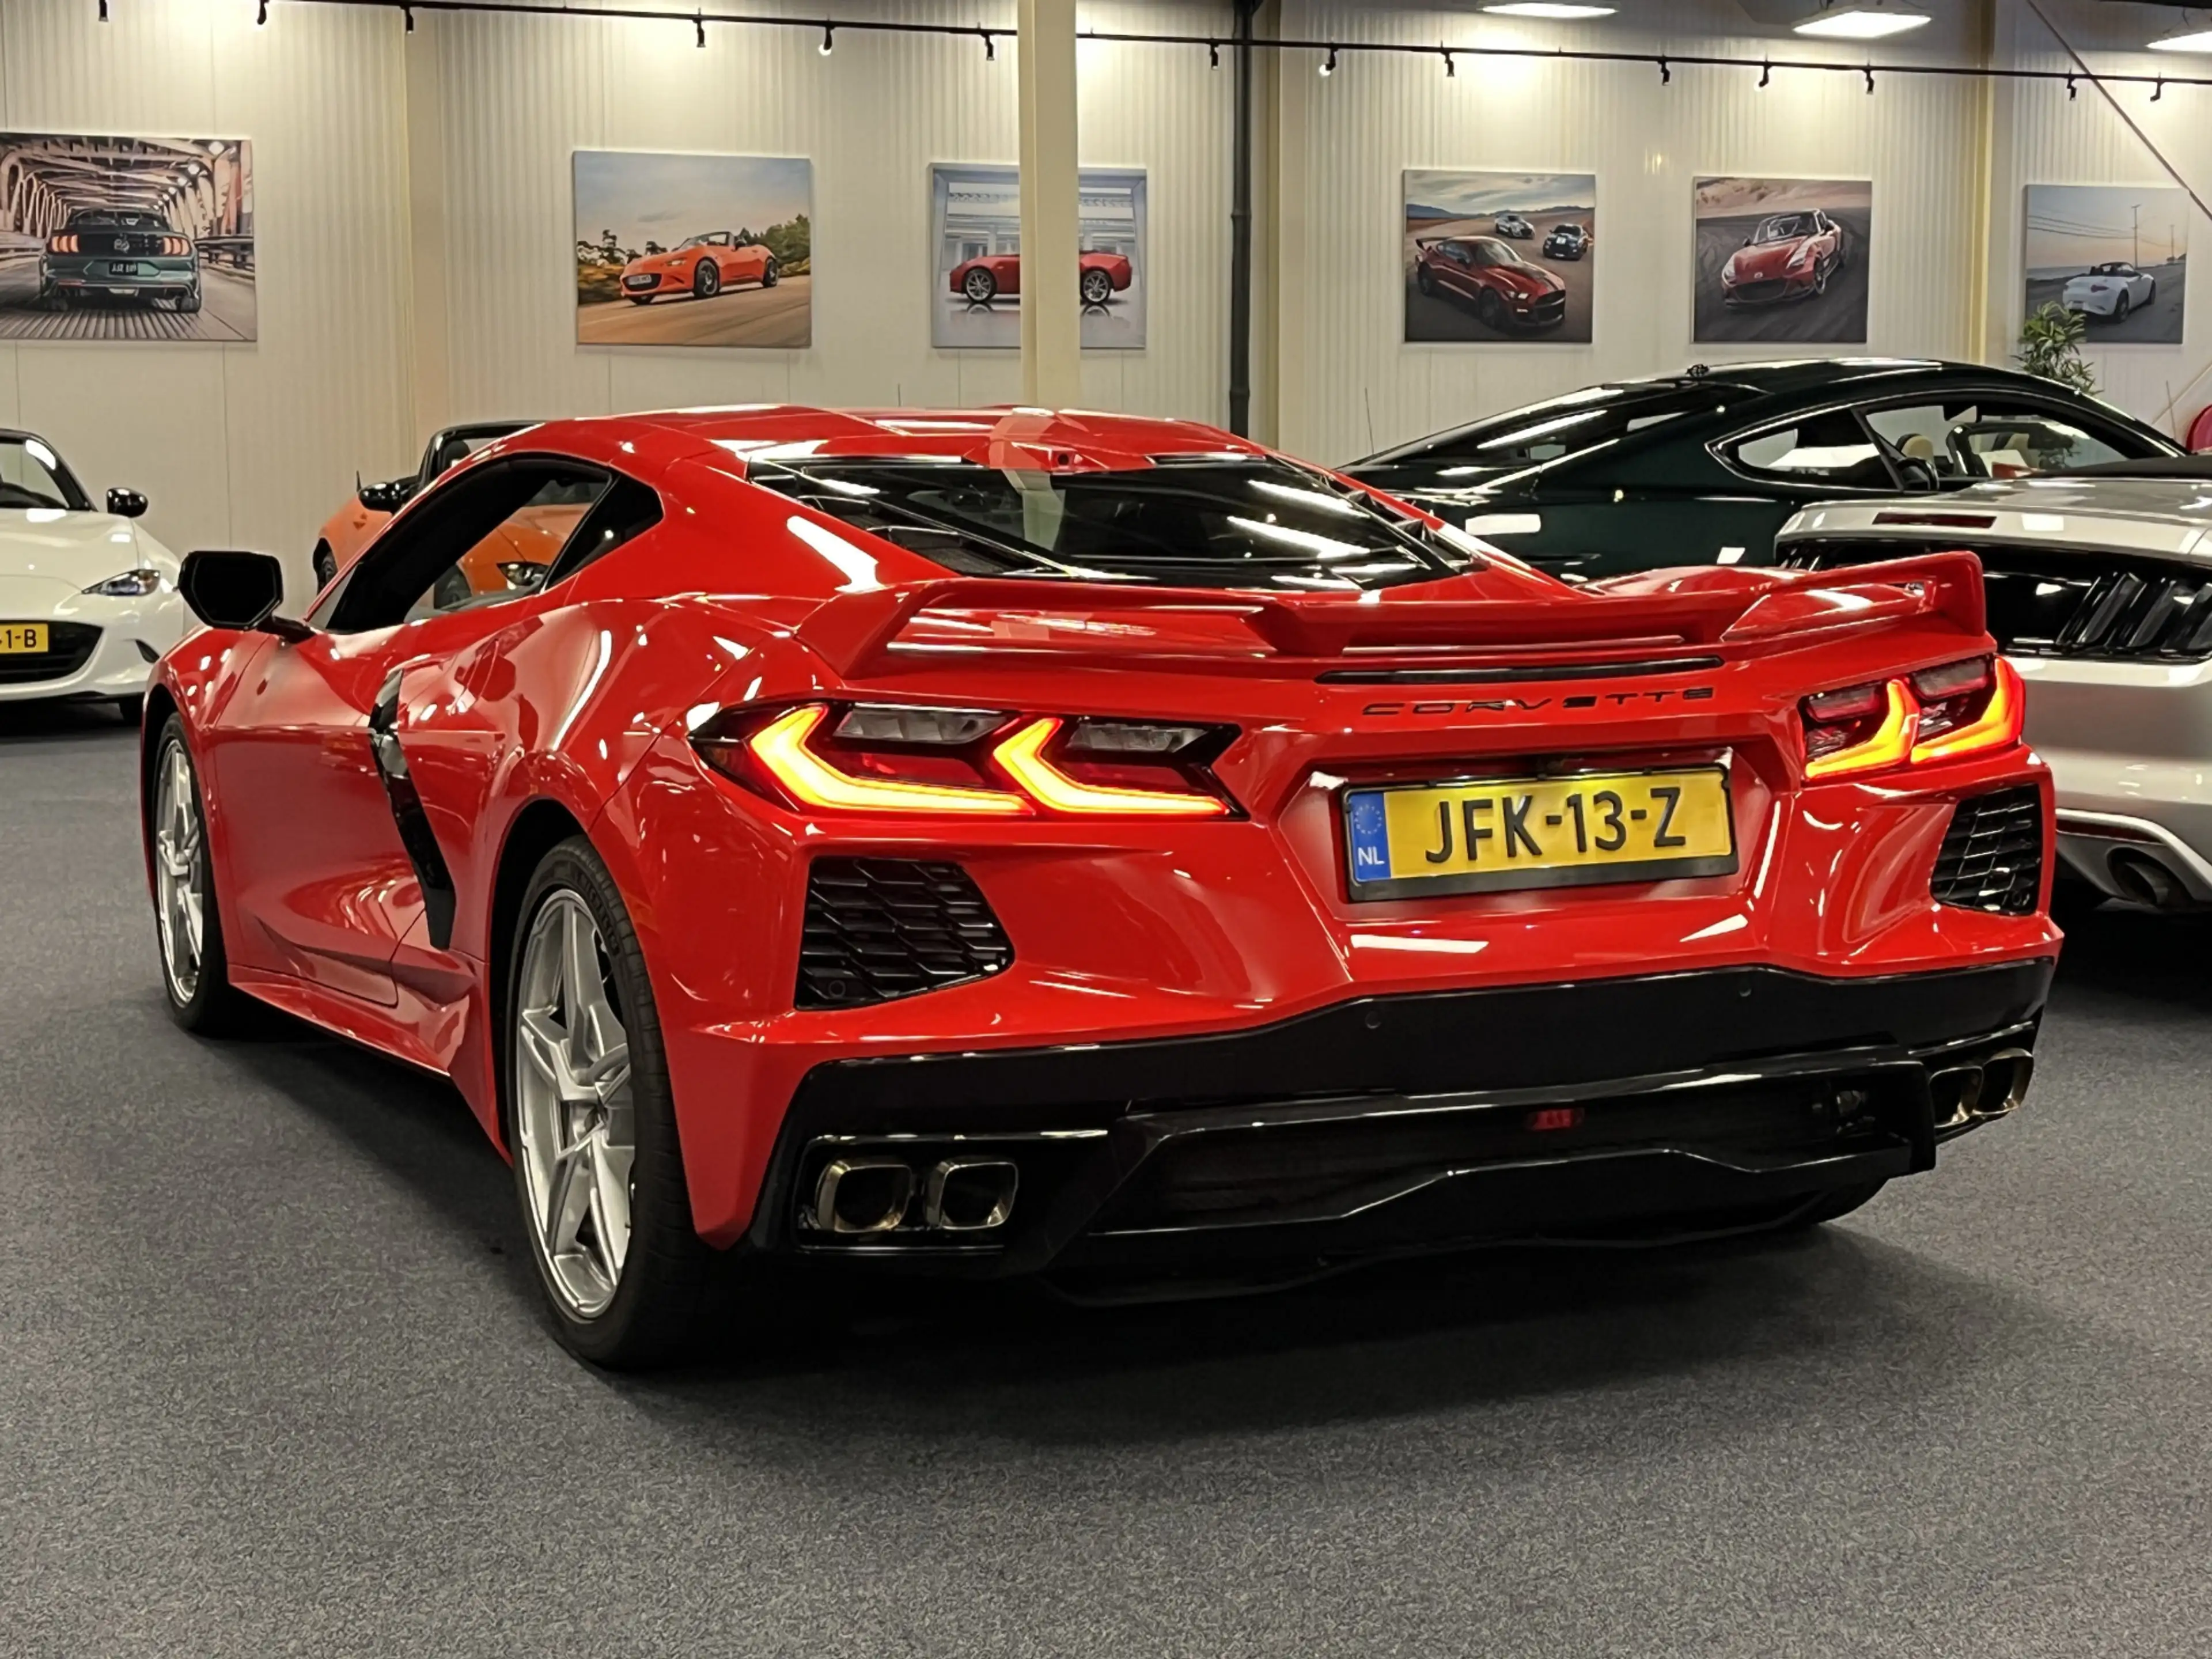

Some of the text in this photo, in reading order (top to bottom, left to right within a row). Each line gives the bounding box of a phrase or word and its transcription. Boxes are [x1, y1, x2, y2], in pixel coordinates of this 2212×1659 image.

[1361, 687, 1714, 715] CORVETTE
[1425, 786, 1686, 864] JFK-13-Z
[1357, 846, 1385, 866] NL
